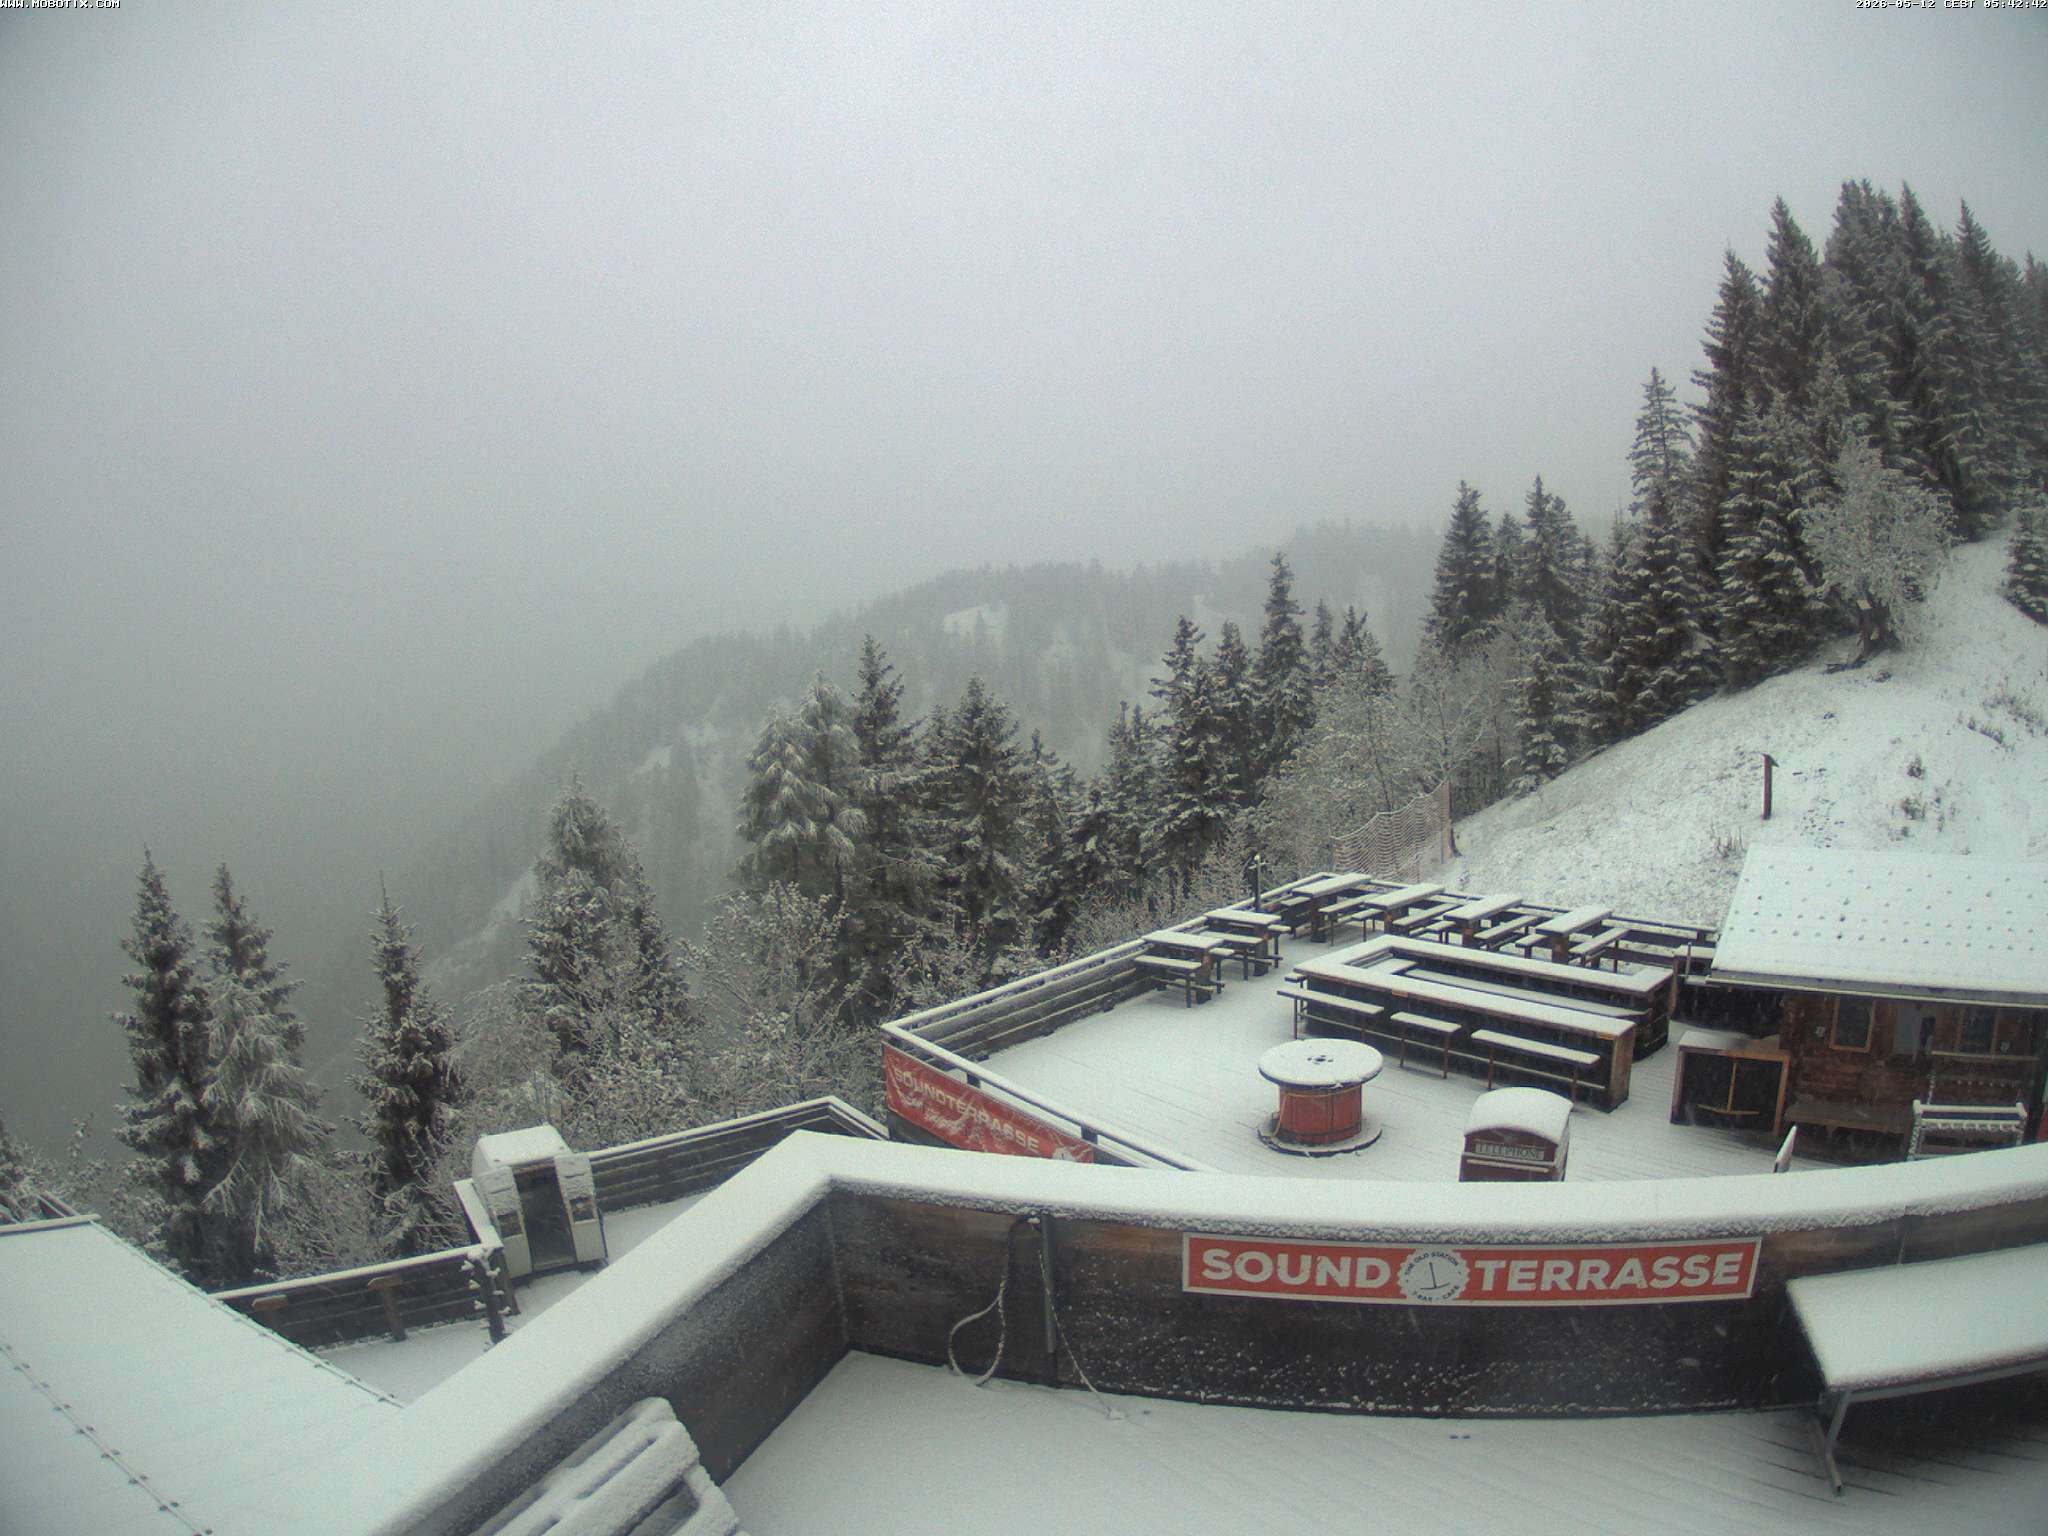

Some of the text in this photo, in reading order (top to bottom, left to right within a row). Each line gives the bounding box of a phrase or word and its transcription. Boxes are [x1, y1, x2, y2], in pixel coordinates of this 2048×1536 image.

[894, 1067, 1041, 1154] SOUNDTERRASSE
[1477, 1144, 1544, 1160] TELEPHONE
[1201, 1247, 1744, 1292] SOUND TERRASSE
